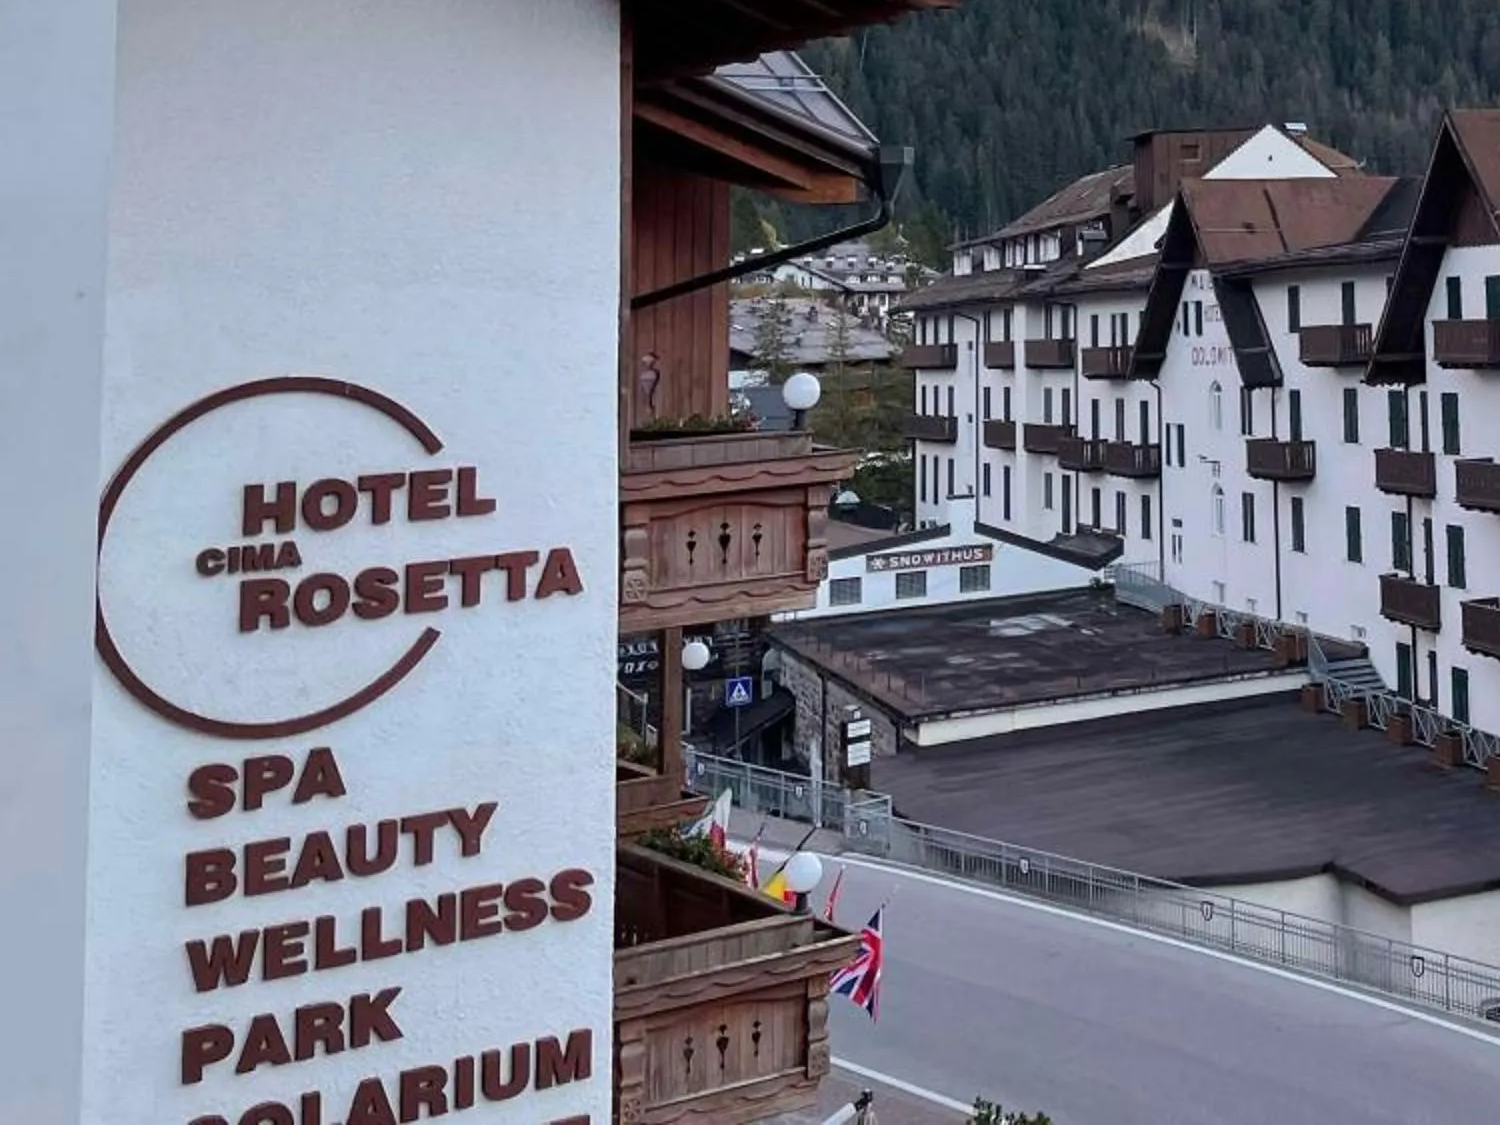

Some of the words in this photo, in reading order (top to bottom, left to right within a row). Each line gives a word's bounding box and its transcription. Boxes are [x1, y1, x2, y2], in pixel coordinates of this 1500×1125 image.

[242, 467, 496, 536] HOTEL
[195, 541, 301, 577] CIMA
[239, 547, 583, 633] ROSETTA
[888, 548, 984, 568] SNOWITHUS
[187, 747, 346, 820] SPA
[185, 802, 498, 906] BEAUTY
[185, 869, 595, 992] WELLNESS
[181, 987, 403, 1085] PARK
[186, 1028, 592, 1125] LARIUM
